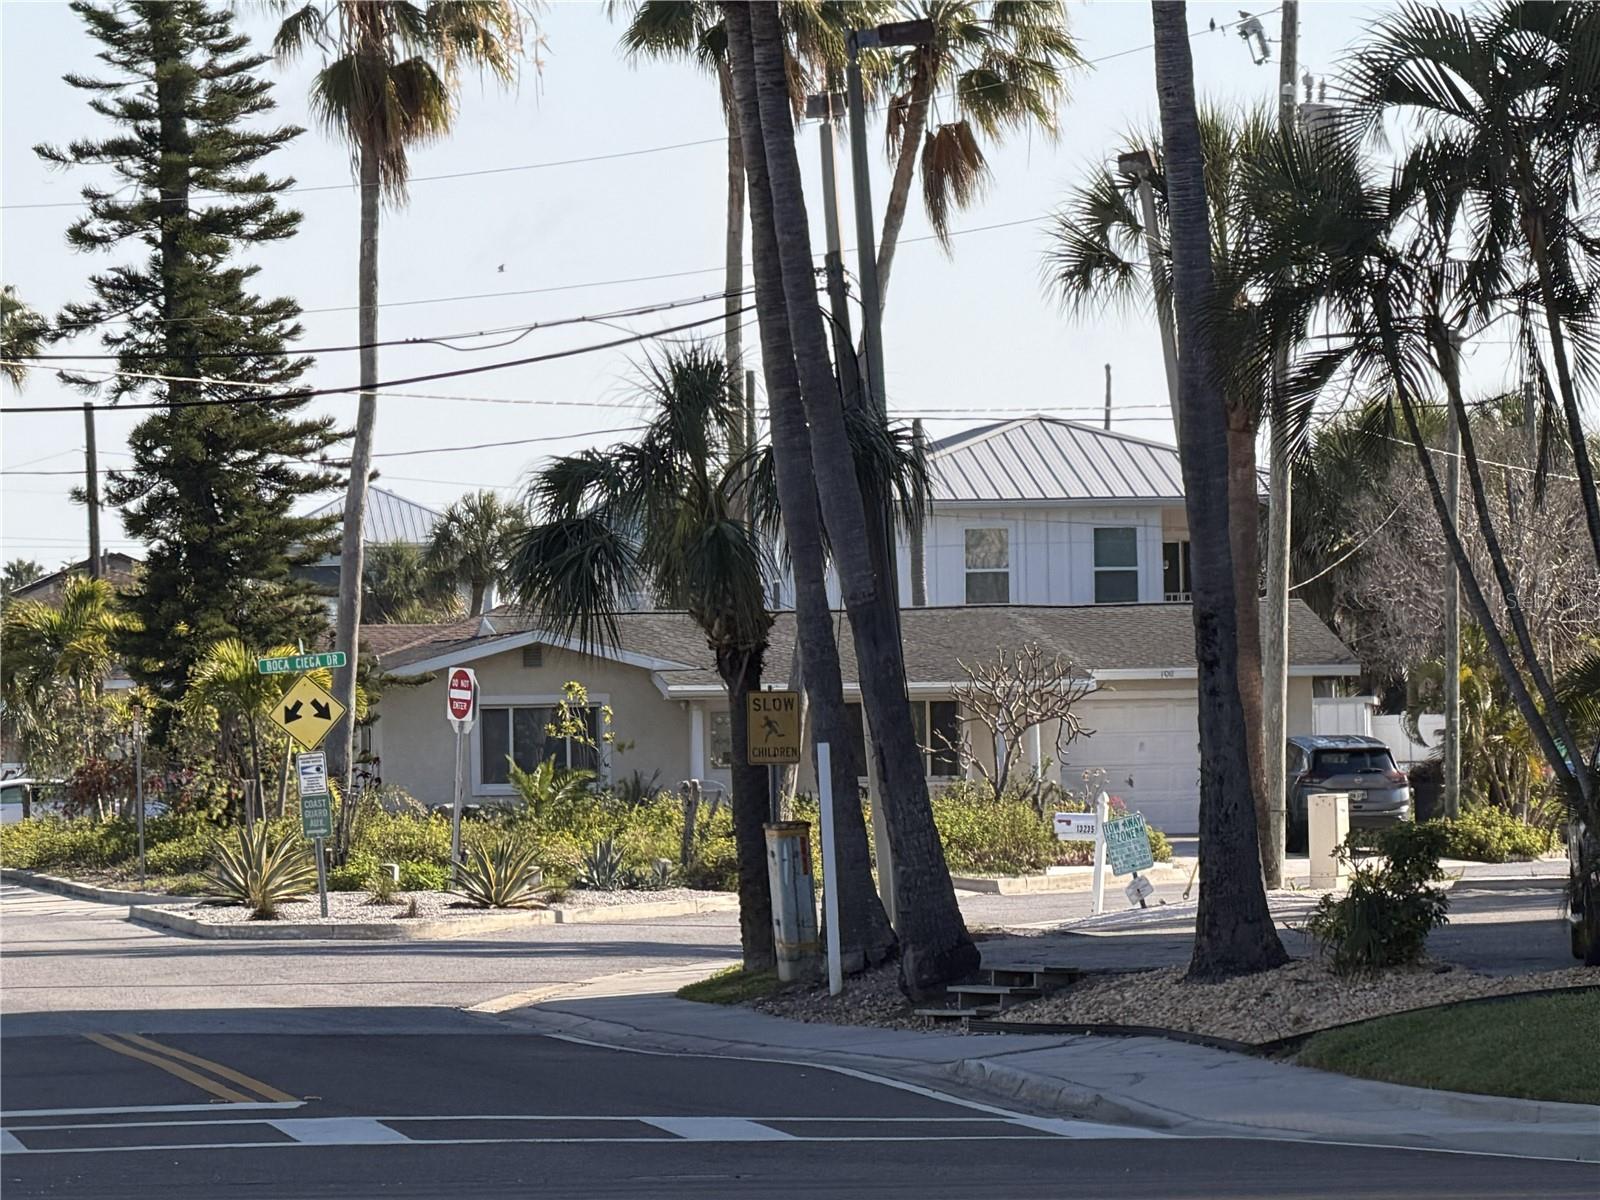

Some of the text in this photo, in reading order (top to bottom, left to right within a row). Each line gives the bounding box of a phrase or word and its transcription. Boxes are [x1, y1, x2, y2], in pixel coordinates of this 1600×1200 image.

[266, 654, 338, 672] BOCA CIEGA DR
[452, 679, 470, 688] DO NOT
[452, 701, 467, 710] ENTER
[752, 697, 795, 712] SLOW
[751, 746, 798, 758] CHILDREN
[304, 800, 326, 809] COAST
[304, 809, 328, 818] GUARD
[1076, 824, 1095, 833] 13235
[1116, 828, 1136, 842] ZONE
